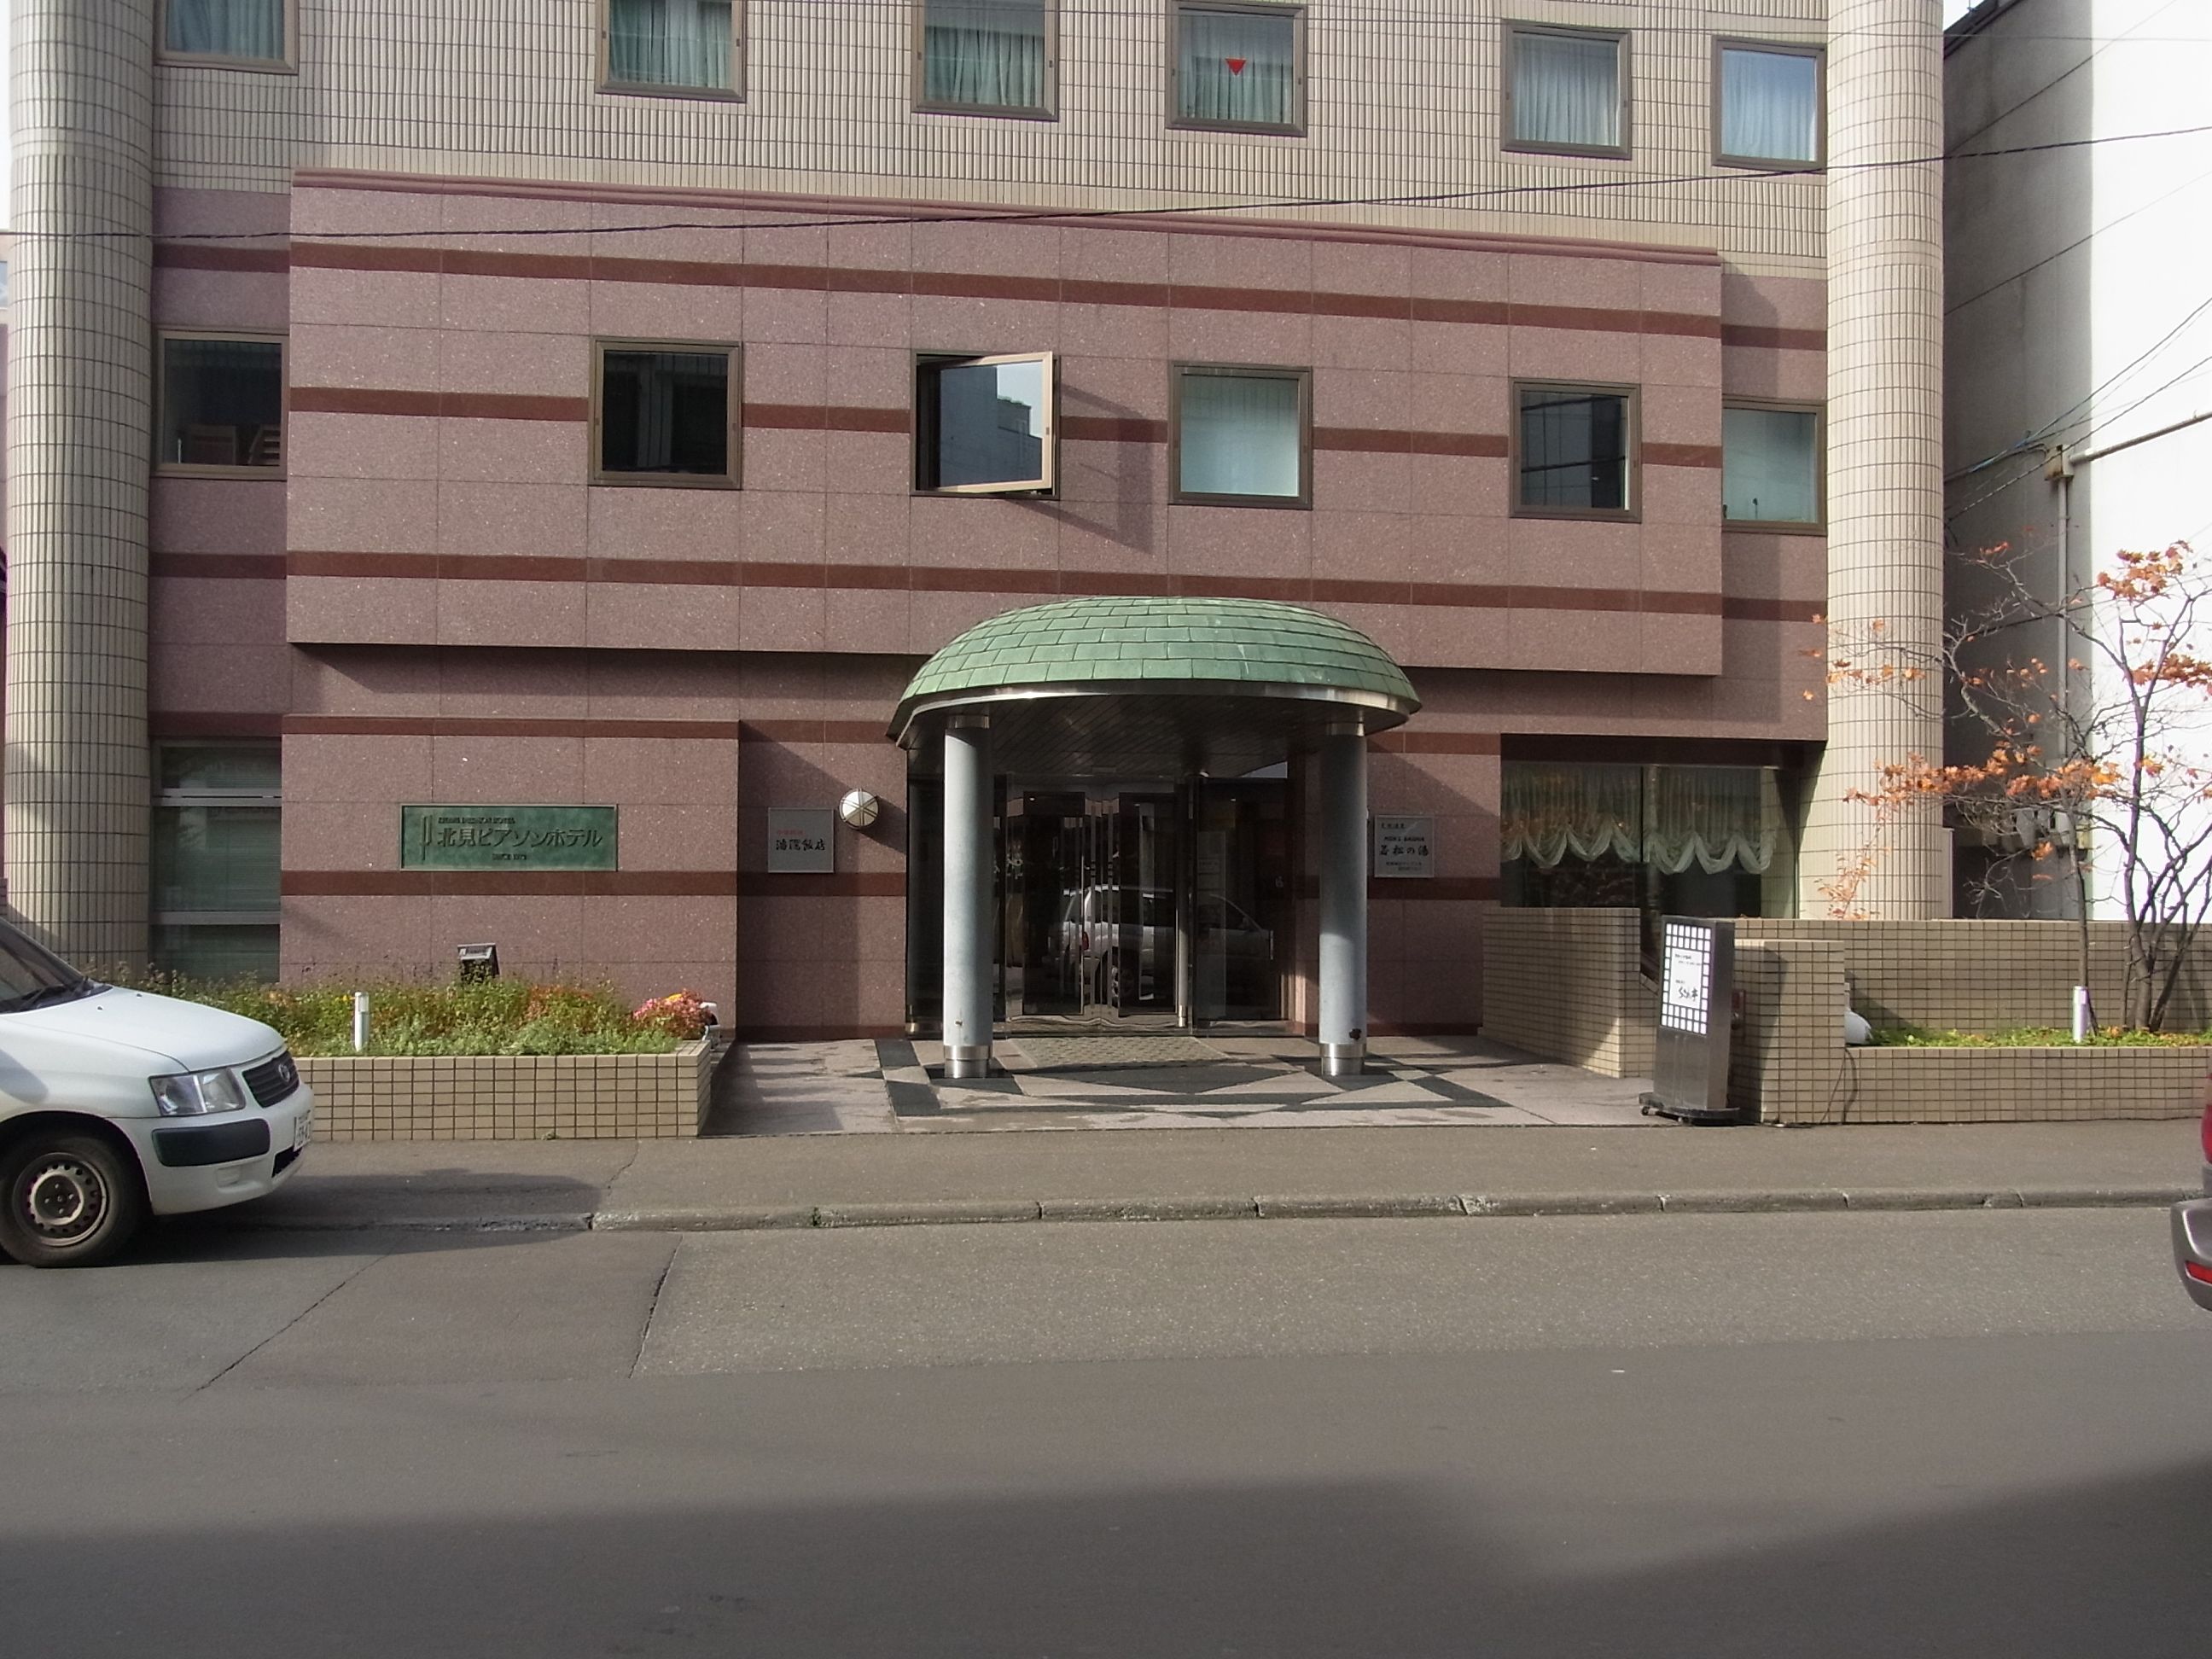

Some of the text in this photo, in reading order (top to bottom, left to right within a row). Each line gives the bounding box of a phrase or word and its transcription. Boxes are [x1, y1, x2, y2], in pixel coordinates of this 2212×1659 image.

[437, 828, 602, 847] 北見ピアソンホテル
